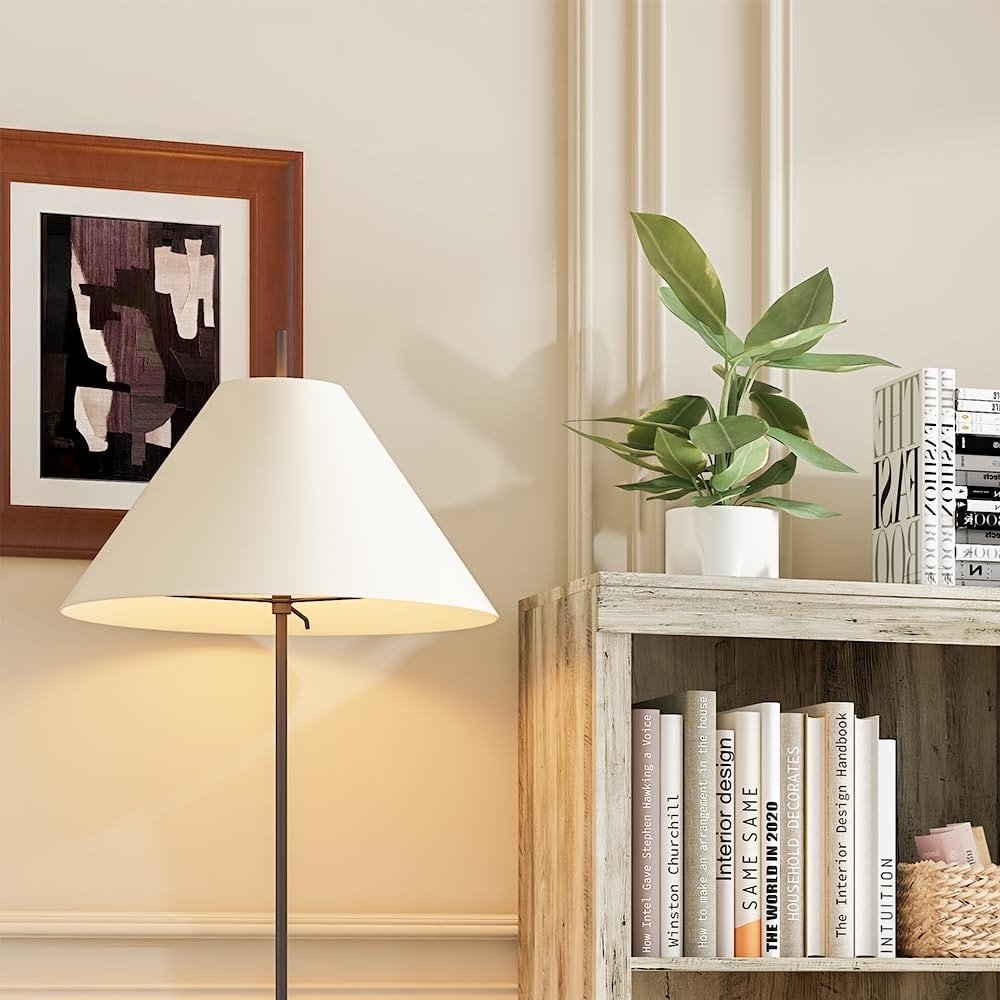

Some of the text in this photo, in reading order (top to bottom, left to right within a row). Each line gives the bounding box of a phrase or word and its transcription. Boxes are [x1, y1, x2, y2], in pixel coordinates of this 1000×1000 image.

[642, 715, 651, 746] Voice
[642, 765, 654, 808] Hawking
[642, 815, 653, 857] Stephen
[698, 696, 710, 948] How to make an arrangement in the house
[716, 737, 735, 881] Interior design
[787, 746, 800, 921] HOUSEHOLD DECORATES
[836, 712, 849, 938] The Interior Design Handbook
[642, 865, 651, 890] Gave
[668, 795, 680, 948] Winston Churchill
[742, 787, 758, 910] SAME SAME
[766, 801, 778, 952] THE WORLD IN 2020
[642, 895, 651, 927] Intel
[642, 934, 651, 953] How
[881, 858, 893, 953] INTUITION
